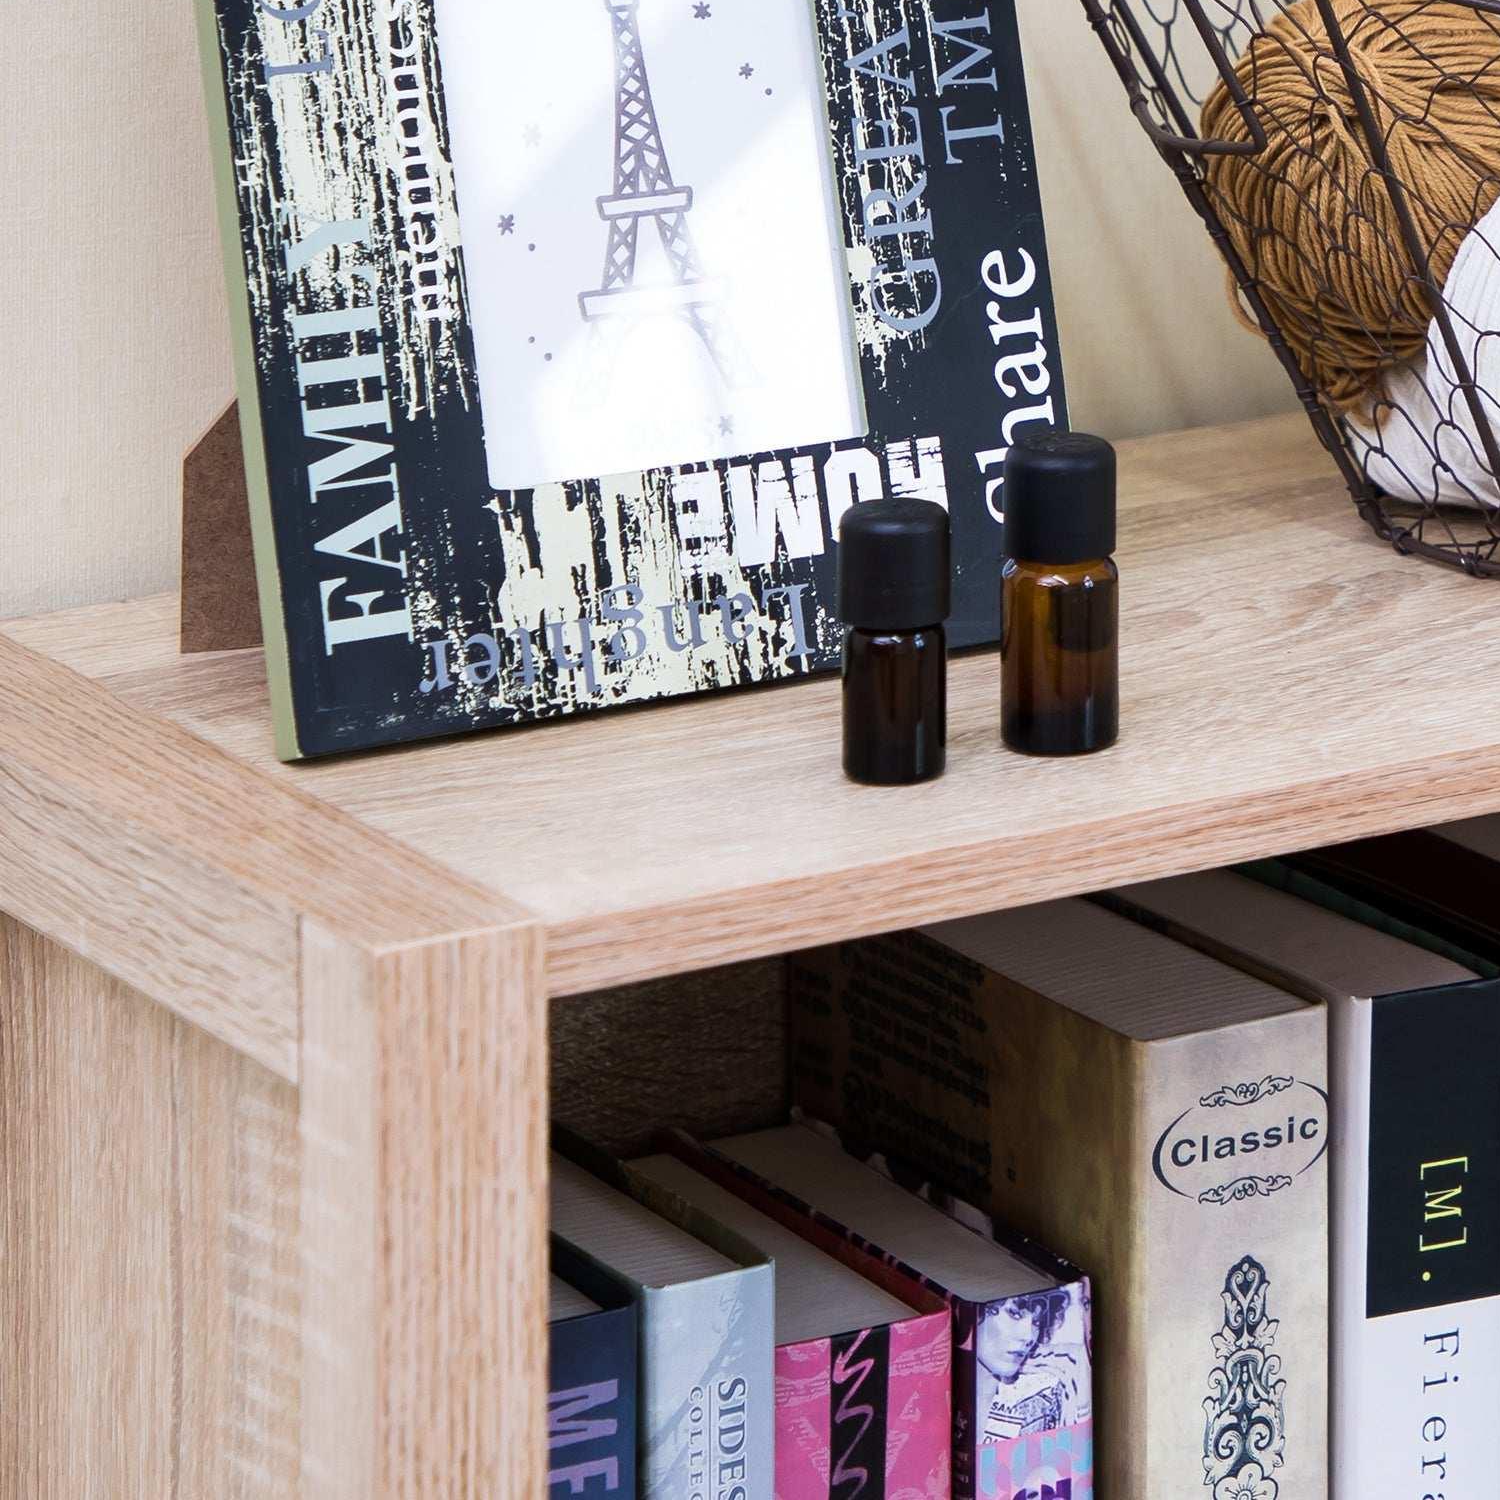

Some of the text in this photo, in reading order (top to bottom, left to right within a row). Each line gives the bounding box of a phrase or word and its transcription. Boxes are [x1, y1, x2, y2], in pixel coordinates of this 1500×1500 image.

[281, 204, 415, 657] FAMILY
[671, 435, 950, 576] HOME
[1170, 1115, 1319, 1168] Classic
